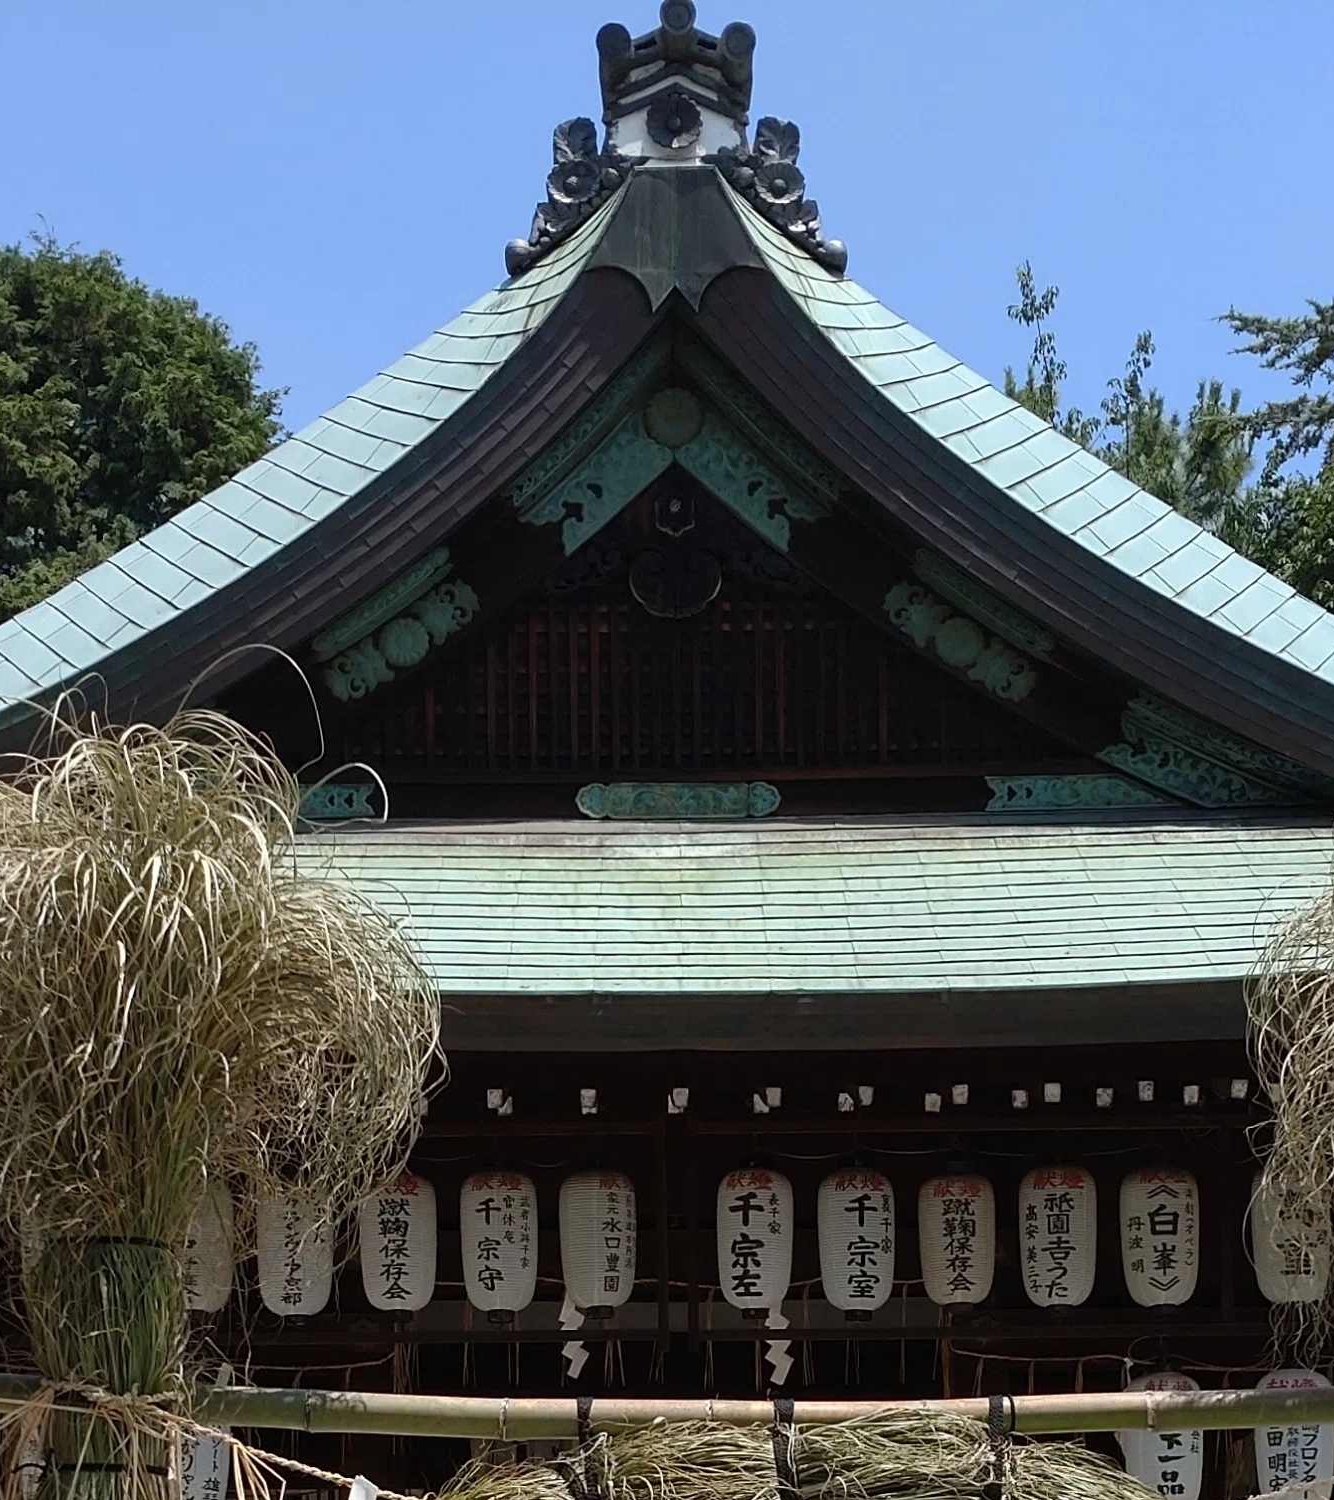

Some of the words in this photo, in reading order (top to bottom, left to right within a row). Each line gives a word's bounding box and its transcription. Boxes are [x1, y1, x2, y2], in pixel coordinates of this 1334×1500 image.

[378, 1197, 413, 1301] 蹴鞠保存会
[475, 1197, 504, 1292] 千宗守
[502, 1194, 516, 1244] 官休庵
[728, 1191, 765, 1298] 千宗左
[768, 1192, 782, 1235] 表千家
[844, 1193, 880, 1299] 千宗室
[879, 1193, 893, 1254] 裏千家
[941, 1198, 977, 1291] 蹴鞠保存会
[1156, 1432, 1185, 1495] 下一品
[1266, 1427, 1289, 1492] 田明宏
